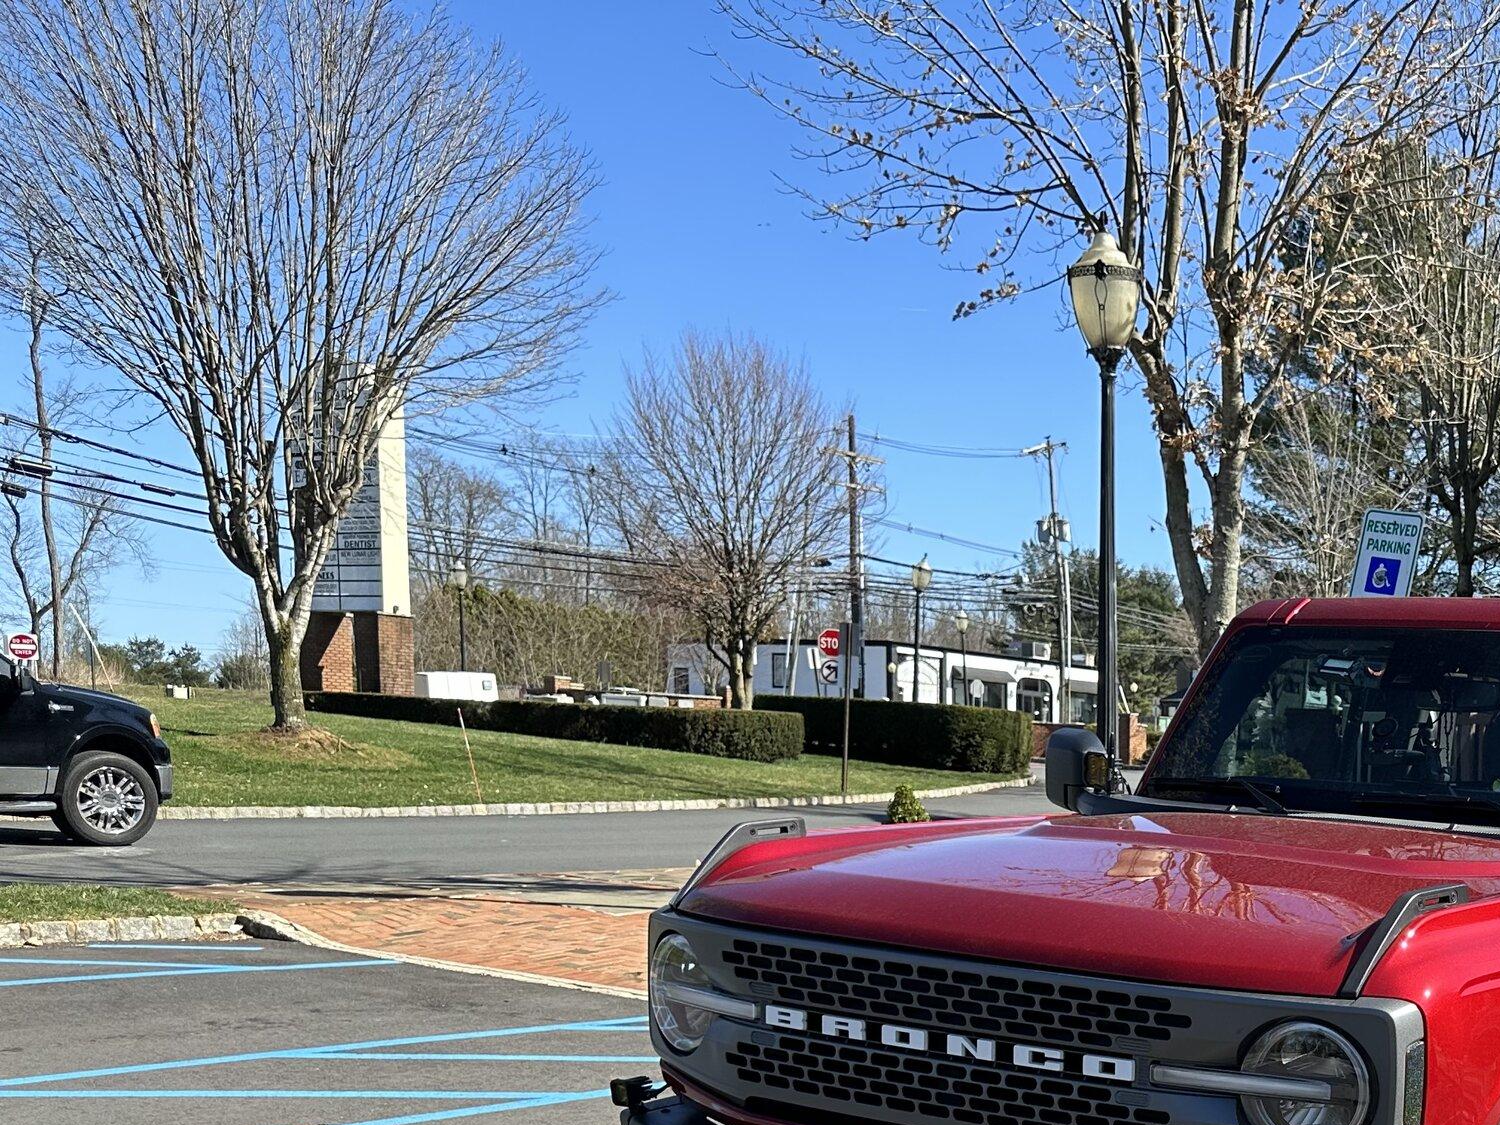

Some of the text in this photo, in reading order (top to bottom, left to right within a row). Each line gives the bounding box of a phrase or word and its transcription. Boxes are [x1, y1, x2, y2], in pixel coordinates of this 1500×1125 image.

[1366, 520, 1418, 537] RESERVED
[344, 540, 376, 548] DENTIST
[1366, 538, 1411, 555] PARKING
[820, 637, 839, 649] STO
[764, 1004, 1136, 1082] BRONCO
